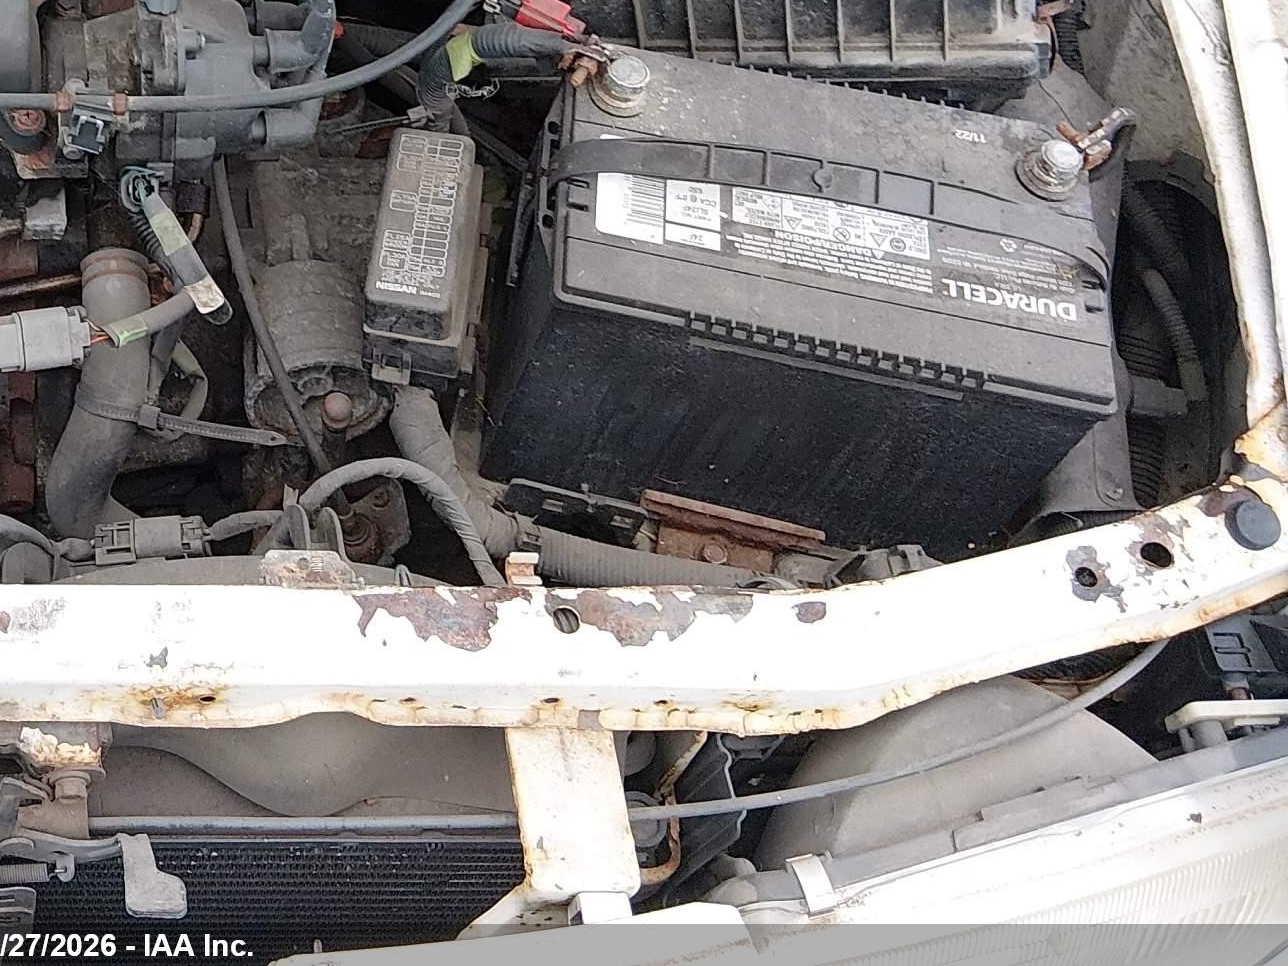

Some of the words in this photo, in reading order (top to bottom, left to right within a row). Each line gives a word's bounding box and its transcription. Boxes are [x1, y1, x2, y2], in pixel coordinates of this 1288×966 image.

[954, 129, 987, 144] 11/22
[688, 233, 703, 241] 24F
[775, 230, 872, 257] DANGER/POISON
[375, 280, 417, 295] NISSAN
[941, 278, 1077, 321] DURACELL
